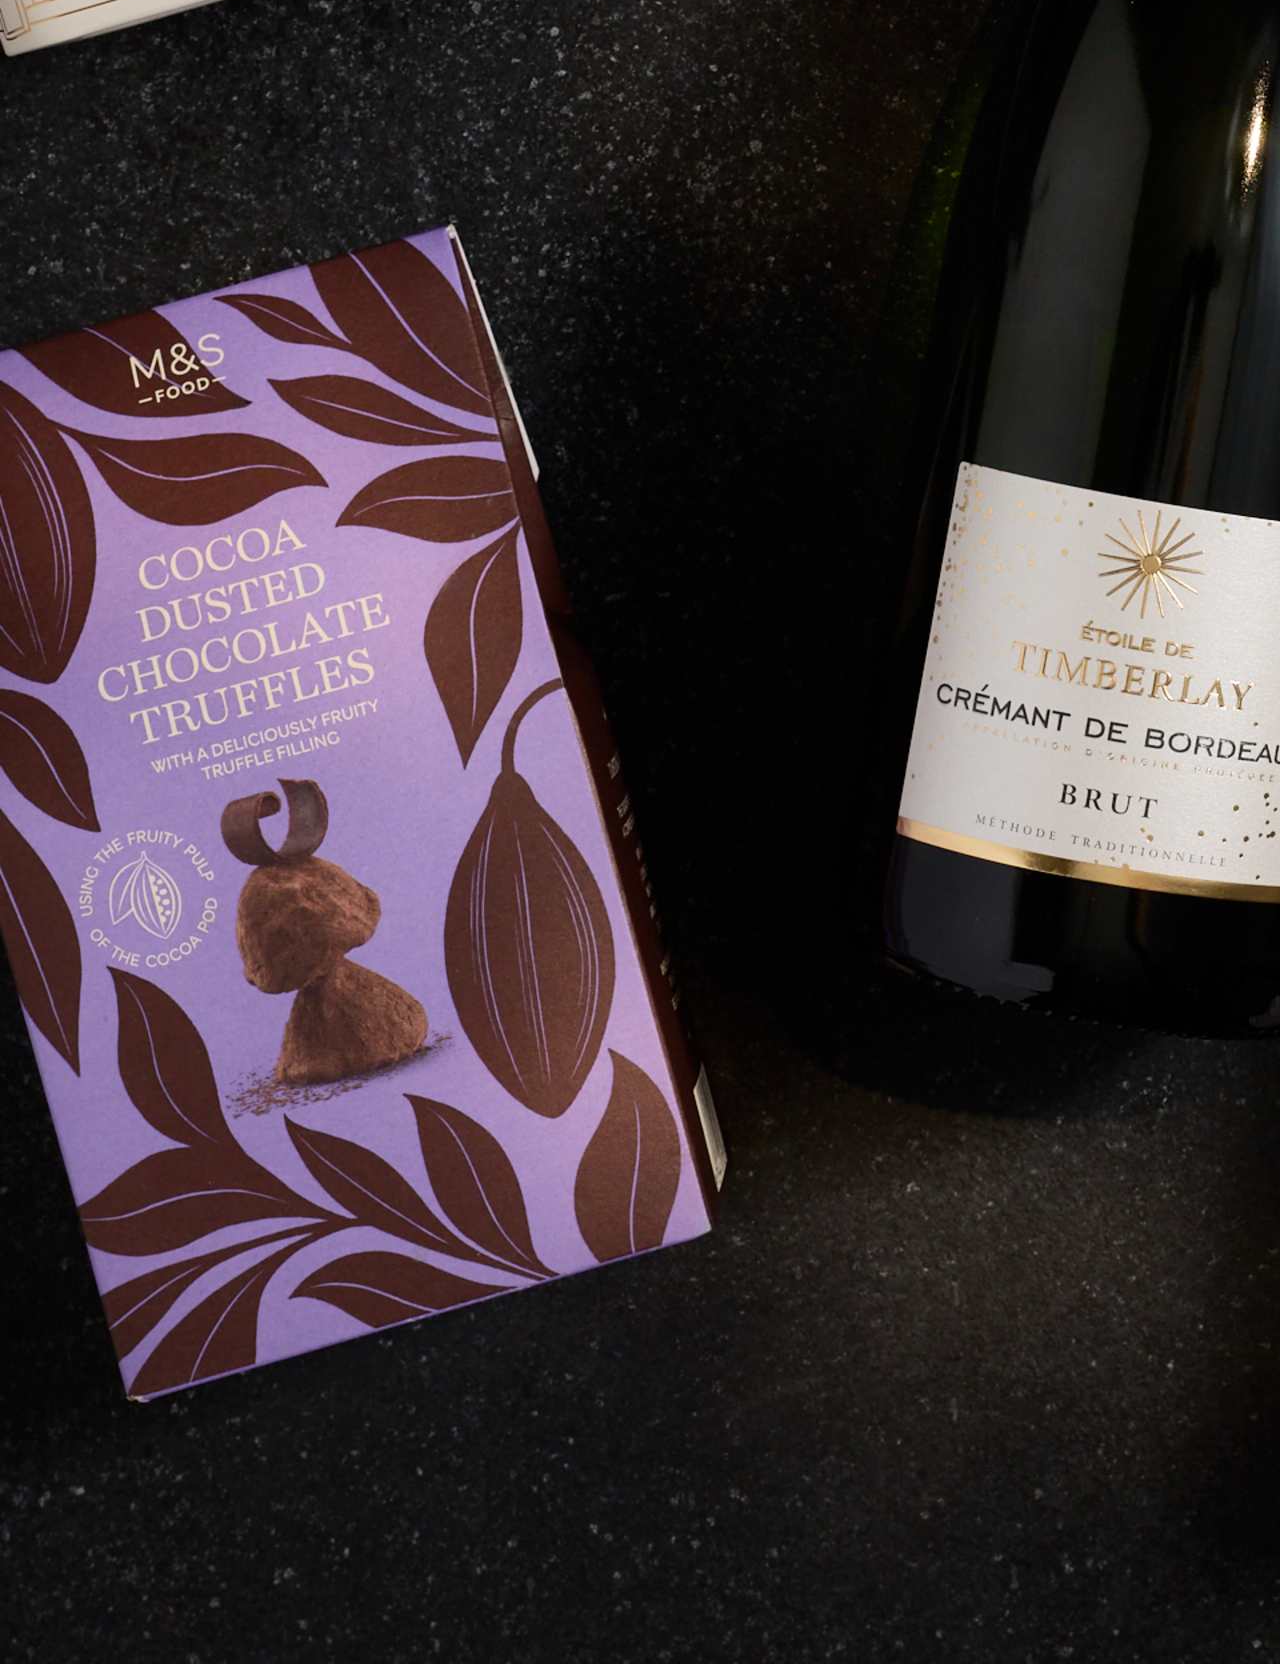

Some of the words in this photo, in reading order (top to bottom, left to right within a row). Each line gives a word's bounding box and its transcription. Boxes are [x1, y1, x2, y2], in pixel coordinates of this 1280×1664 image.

[128, 333, 225, 389] M&S
[138, 519, 307, 591] COCOA
[134, 562, 327, 643] DUSTED
[97, 592, 391, 703] CHOCOLATE
[1010, 639, 1256, 712] TIMBERLAY
[1080, 620, 1156, 654] ÉTOILE
[1164, 640, 1195, 660] DE
[129, 646, 376, 746] TRUFFLES
[936, 682, 1072, 732] CRÉMANT
[1084, 717, 1129, 744] DE
[150, 749, 194, 774] WITH
[196, 747, 210, 763] A
[211, 716, 318, 758] DELICIOUSLY
[320, 698, 380, 727] FRUITY
[200, 748, 275, 780] TRUFFLE
[275, 730, 342, 764] FILLING
[1058, 783, 1159, 819] BRUT
[79, 865, 99, 917] USING
[94, 838, 124, 864] THE
[126, 829, 185, 849] FRUITY
[183, 843, 215, 882] PULP
[974, 812, 1057, 842] MÉTHODE
[1070, 834, 1227, 869] TRADITIONNELLE
[89, 928, 112, 948] OF
[111, 944, 141, 968] THE
[145, 934, 203, 969] COCOA
[196, 897, 218, 934] POD
